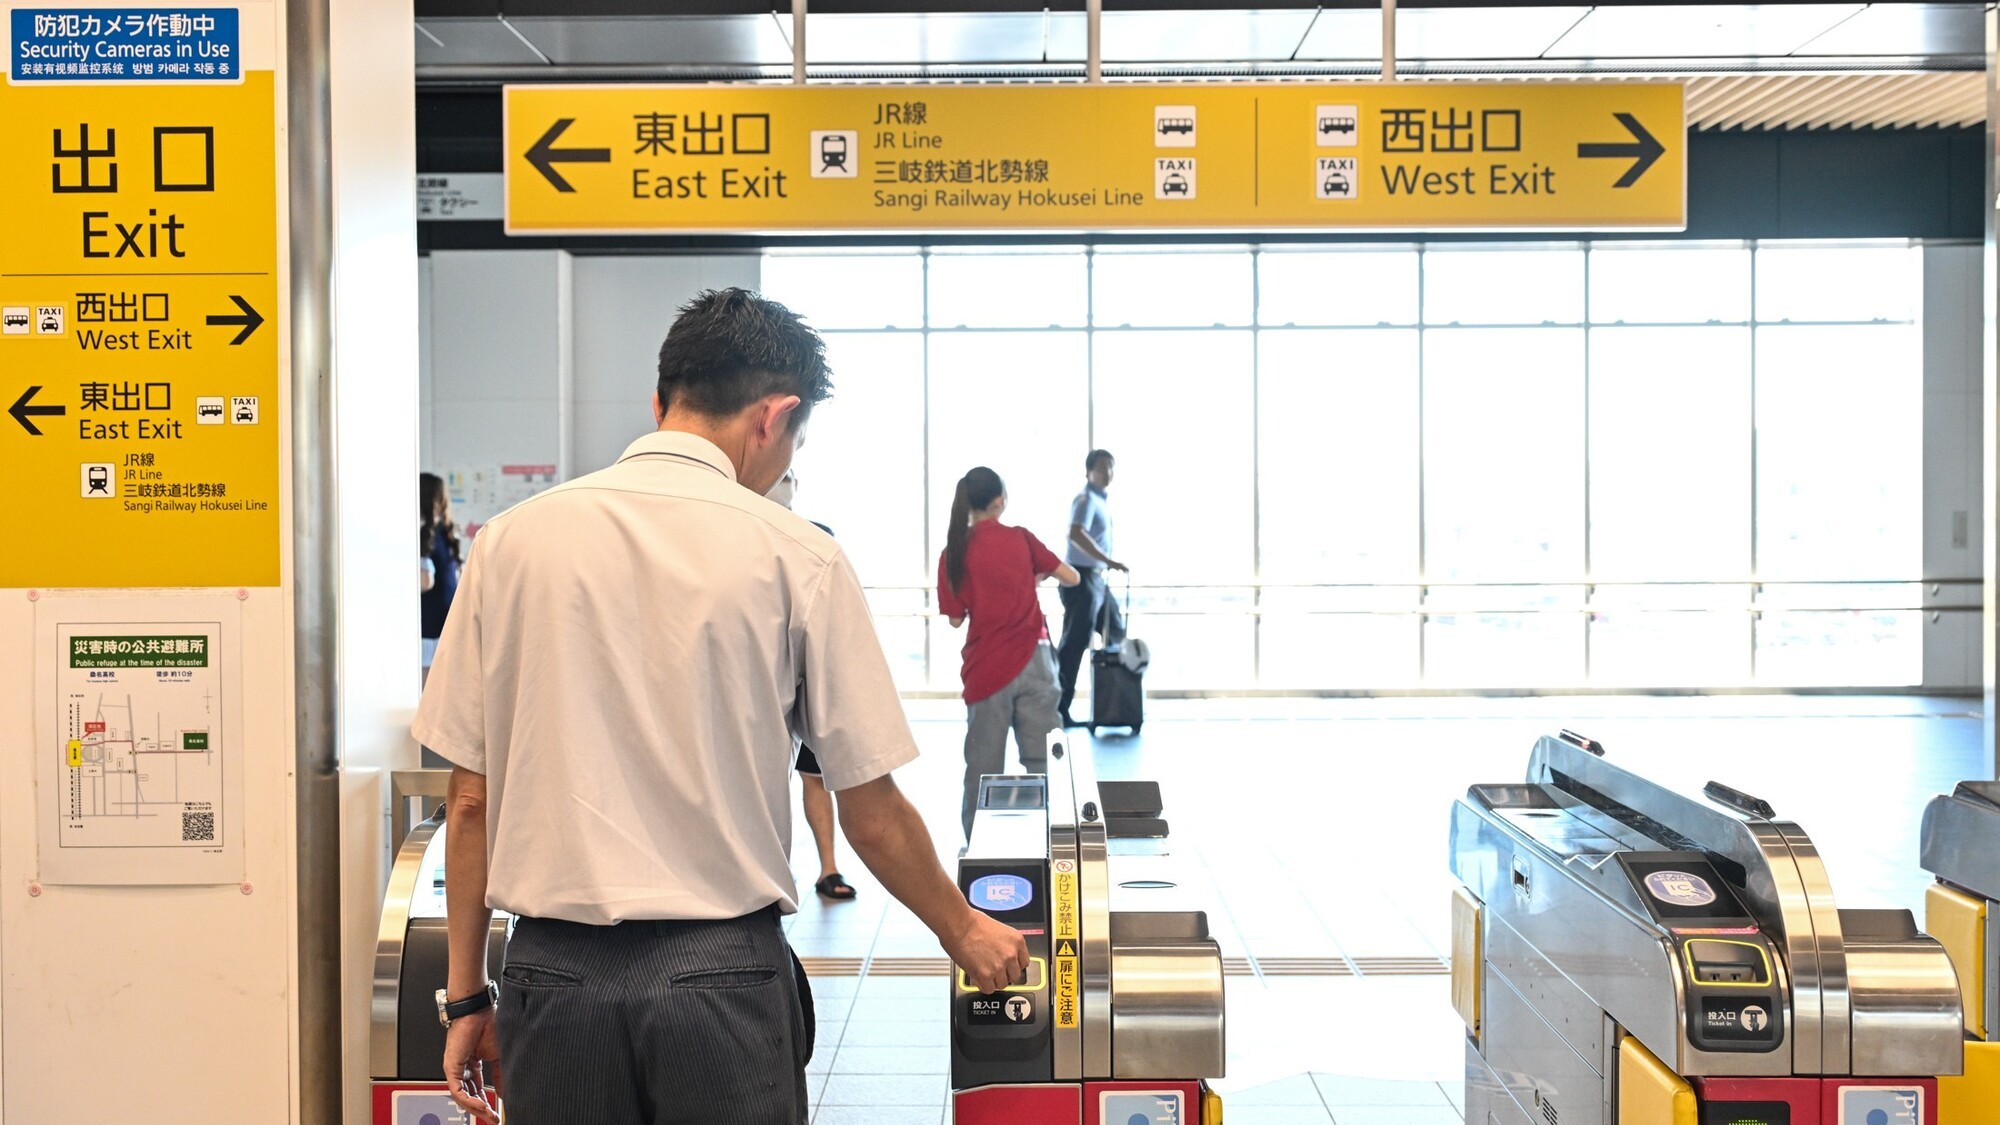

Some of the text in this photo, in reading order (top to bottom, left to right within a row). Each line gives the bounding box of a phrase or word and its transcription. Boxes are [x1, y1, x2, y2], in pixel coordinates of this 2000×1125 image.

[34, 14, 215, 37] 防犯カメラ作動中
[20, 40, 230, 62] Security Cameras in Use
[21, 62, 124, 75] 安装有视频监控系统
[132, 62, 230, 75] 방범 카메라 작동 중
[873, 101, 927, 125] JR線
[633, 111, 770, 156] 東出口
[873, 131, 943, 149] JR Line
[1380, 107, 1522, 153] 西出口
[52, 122, 215, 193] 出口
[1158, 160, 1193, 170] TAXI
[1319, 159, 1354, 170] TAXI
[873, 158, 1049, 184] 三岐鉄道北勢線
[1380, 163, 1556, 195] West Exit
[633, 166, 788, 198] East Exit
[874, 188, 1144, 212] Sangi Railway Hokusei Line
[82, 208, 186, 258] Exit
[38, 308, 61, 316] TAXI
[75, 292, 169, 322] 西出口
[76, 329, 192, 350] West Exit
[80, 381, 171, 411] 東出口
[79, 418, 182, 439] East Exit
[123, 452, 155, 467] JR線
[123, 468, 163, 480] JR Line
[123, 483, 226, 498] 三岐鉄道北勢線
[123, 500, 268, 513] Sangi Railway Hokusei Line
[74, 639, 204, 655] 災害時の公共避難所
[75, 659, 203, 668] Public refuge at the time of the disaster
[992, 888, 1010, 896] IC
[1058, 873, 1073, 936] かけこみ禁止
[1059, 960, 1074, 1025] 扉にご注意
[972, 1001, 1000, 1009] 投入口
[1708, 1011, 1736, 1020] 投入口
